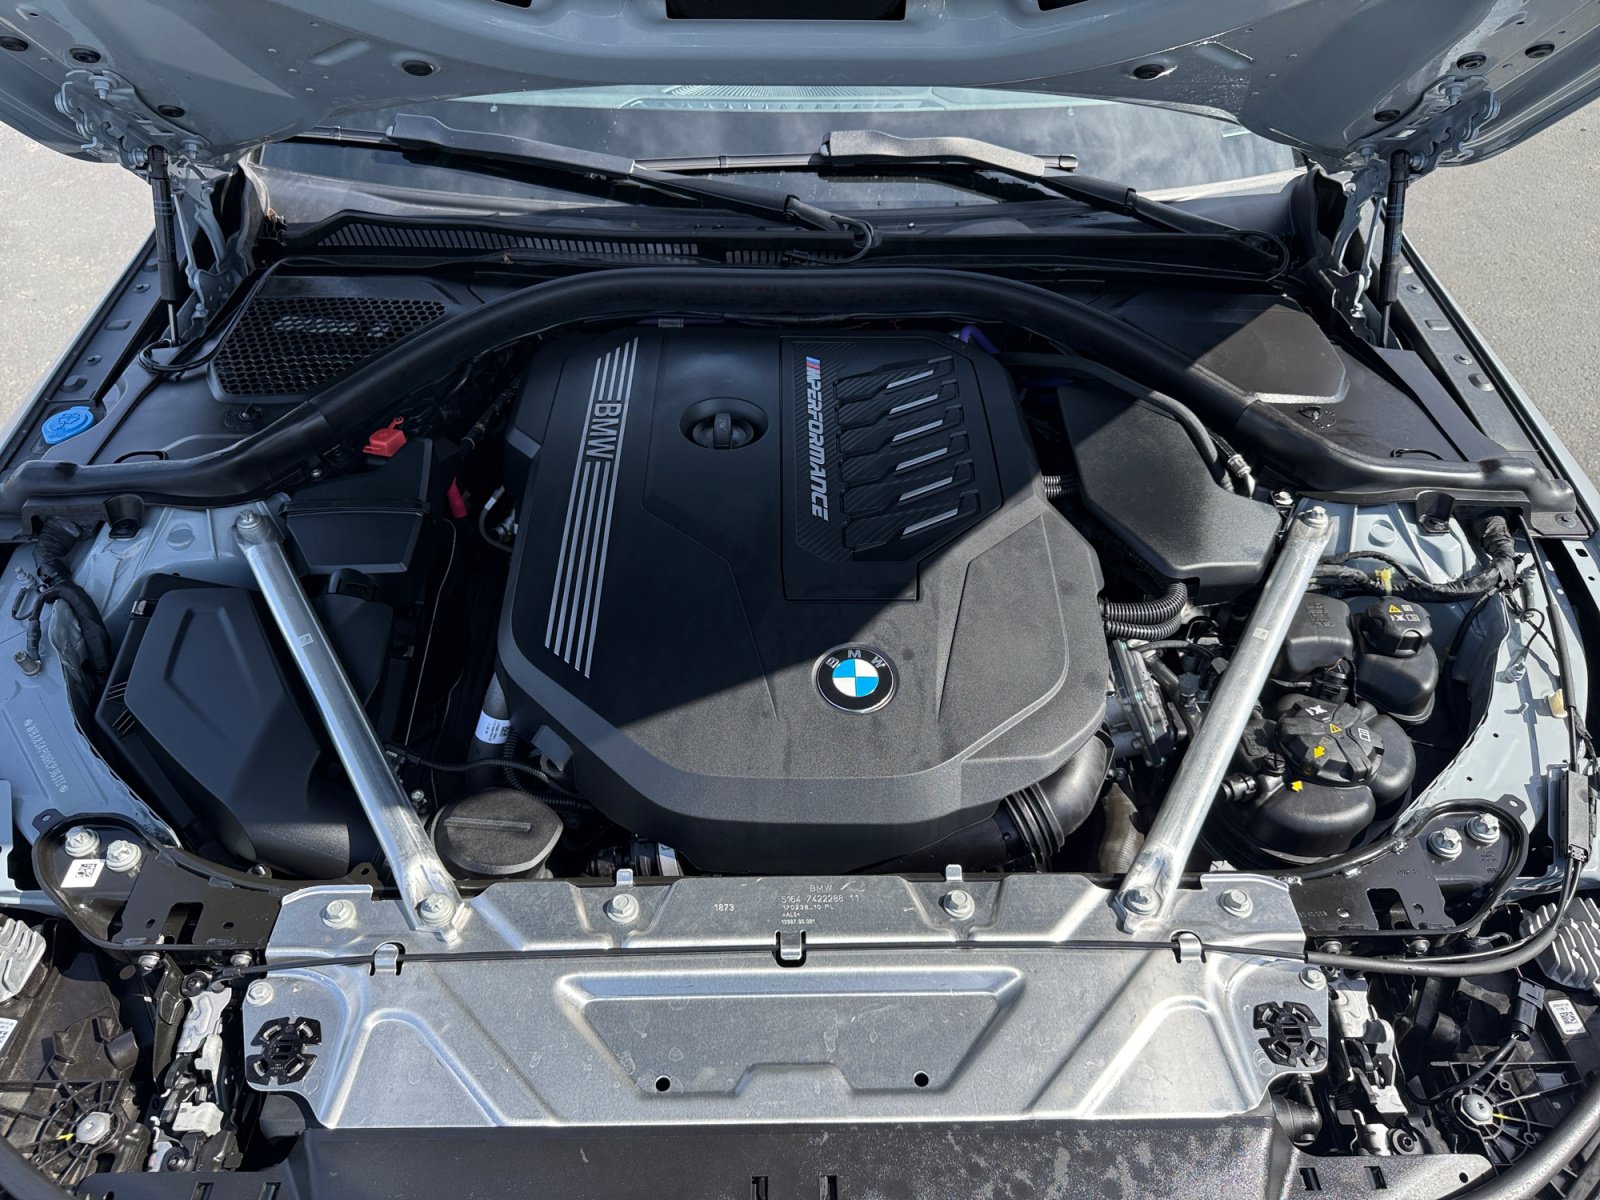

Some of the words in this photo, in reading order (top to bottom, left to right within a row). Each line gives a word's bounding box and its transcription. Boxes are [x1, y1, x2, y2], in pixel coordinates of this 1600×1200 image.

[586, 403, 622, 459] BMW
[806, 379, 829, 522] PERFORMANCE
[825, 649, 886, 669] BMW
[809, 884, 832, 893] BMW
[714, 903, 735, 912] 1873
